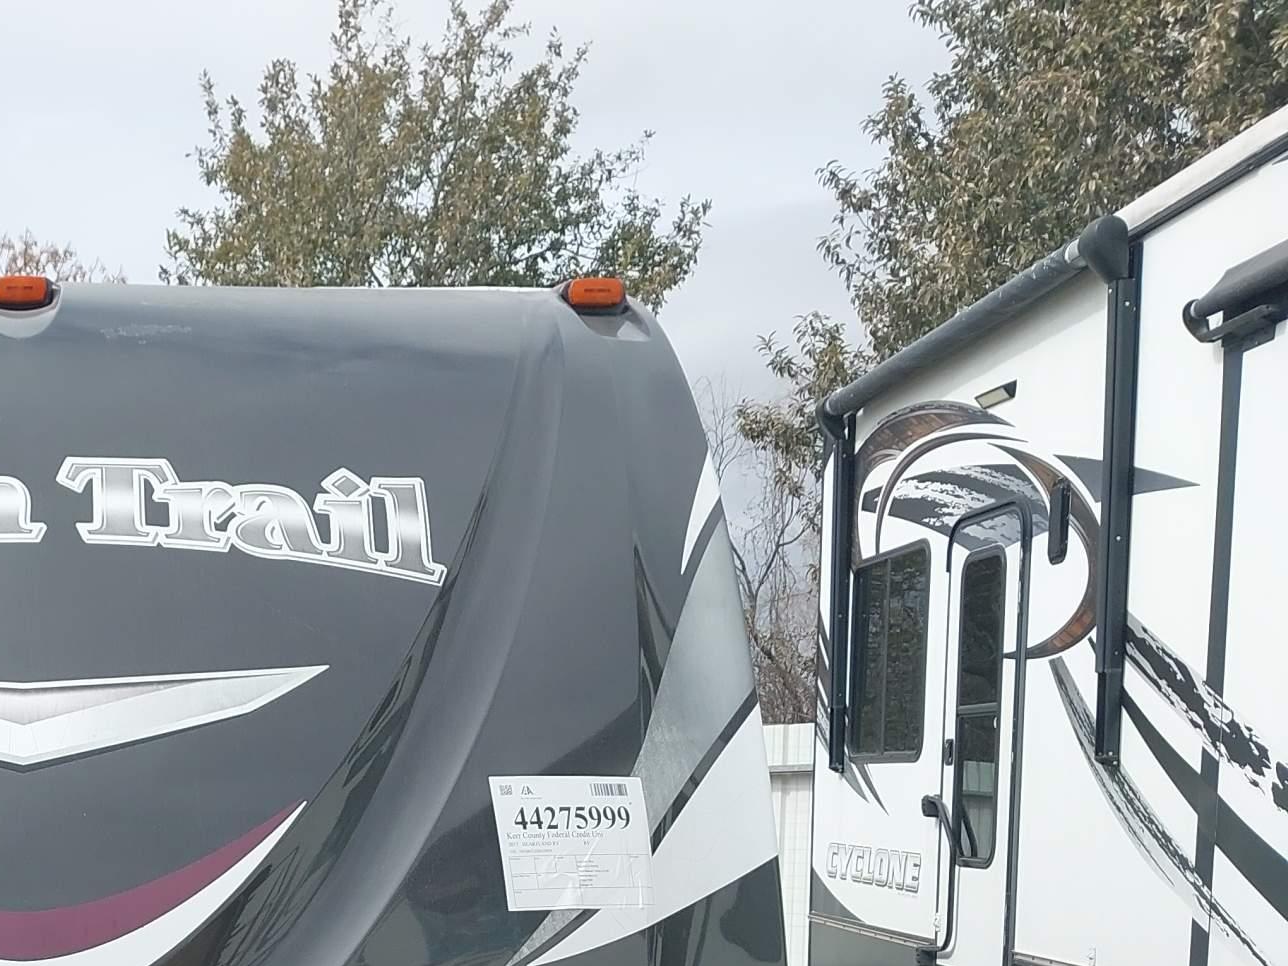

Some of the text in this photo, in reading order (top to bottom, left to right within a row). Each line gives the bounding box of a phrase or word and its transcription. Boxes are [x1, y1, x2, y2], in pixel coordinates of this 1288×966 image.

[56, 456, 446, 586] Trail
[514, 806, 630, 829] 44275999
[522, 831, 545, 840] County
[546, 831, 570, 839] Federal
[571, 830, 591, 838] Credit
[826, 842, 921, 893] CYCLONE
